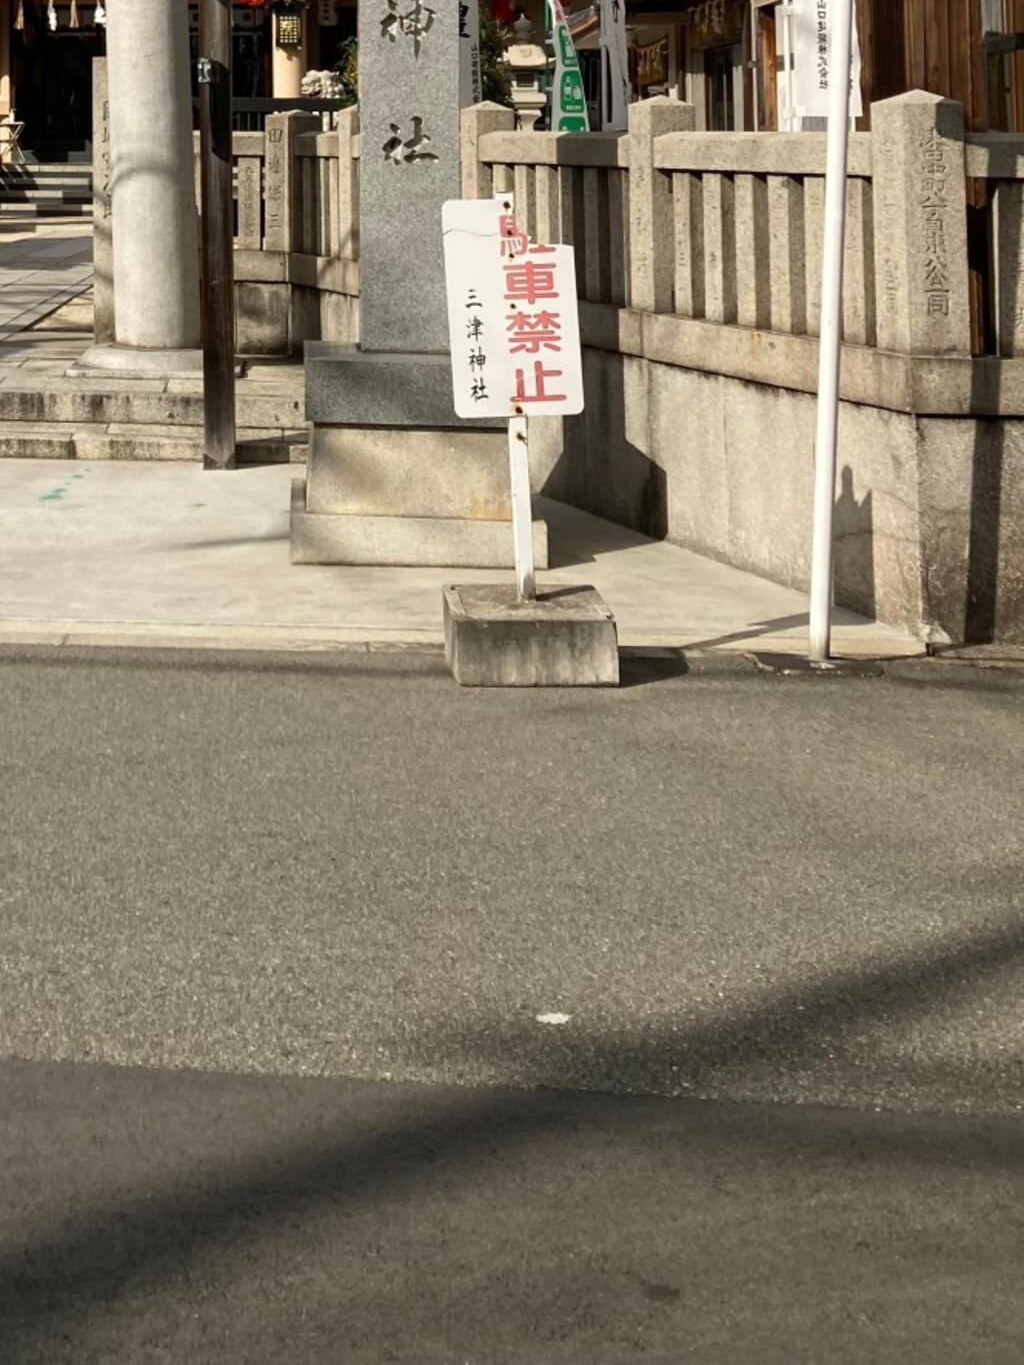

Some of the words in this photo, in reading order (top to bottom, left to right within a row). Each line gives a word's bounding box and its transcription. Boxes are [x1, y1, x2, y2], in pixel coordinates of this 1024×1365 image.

[465, 289, 489, 403] 三津神社
[499, 215, 567, 403] 駐車禁止
